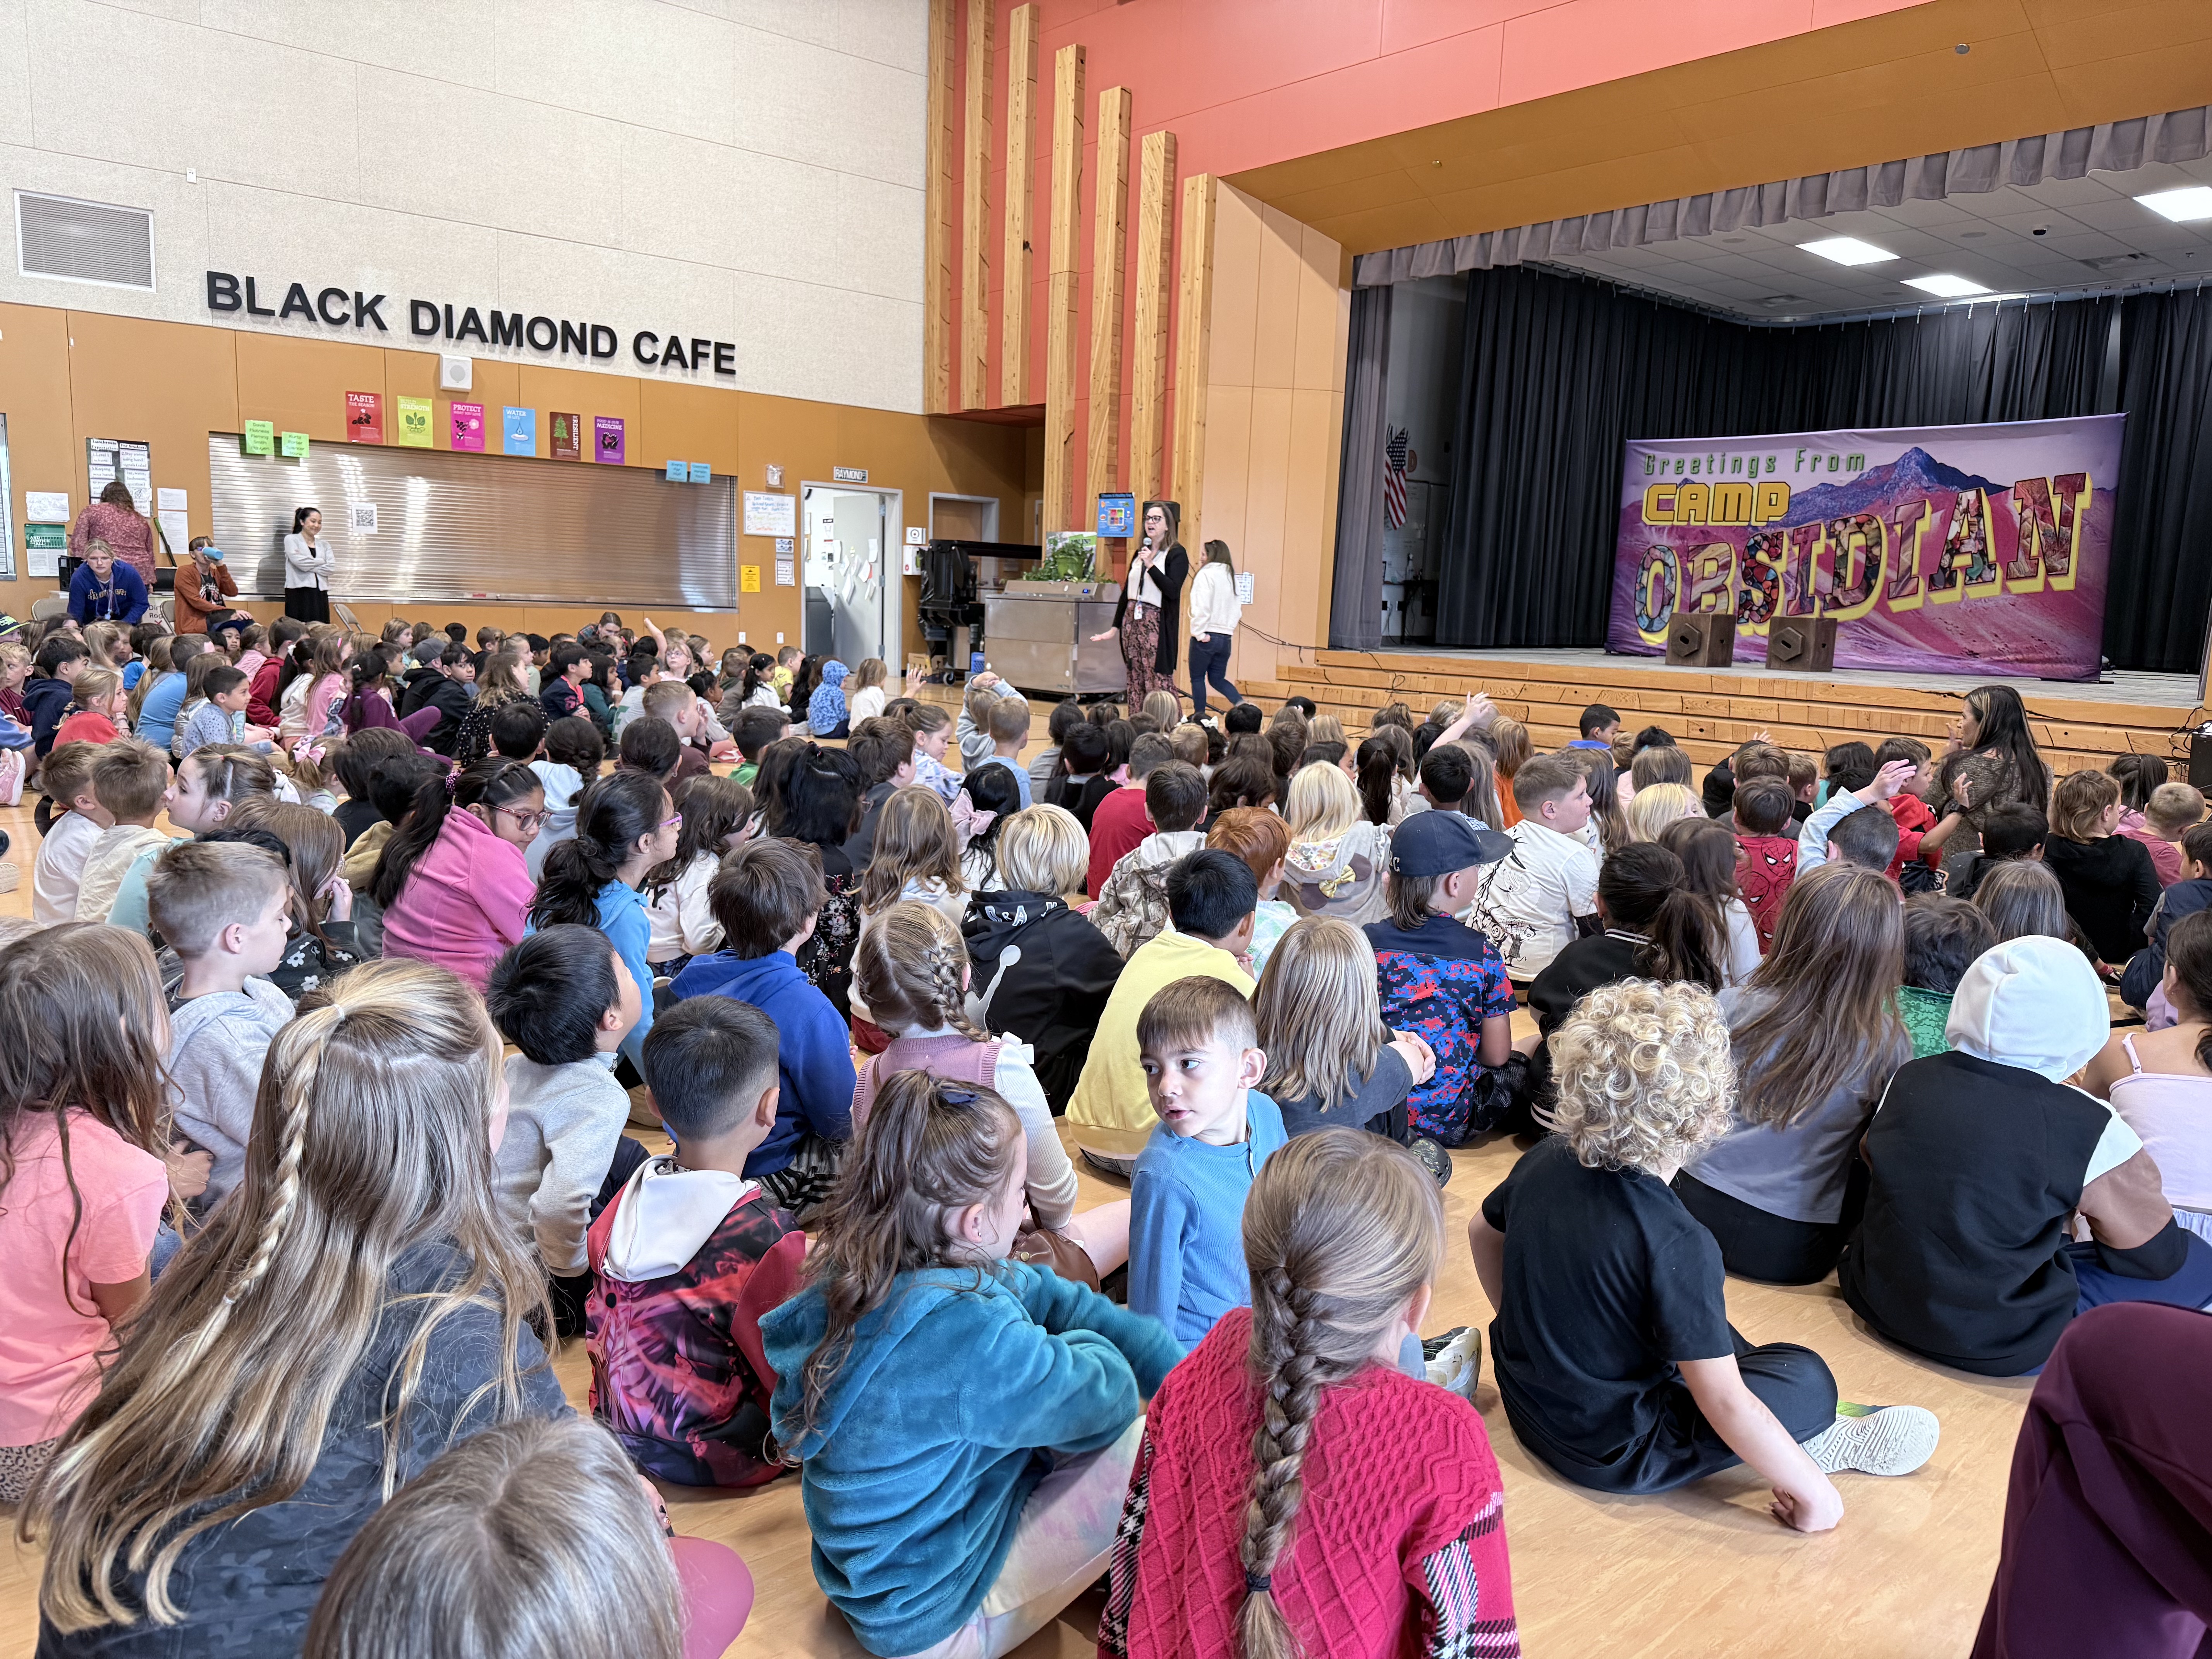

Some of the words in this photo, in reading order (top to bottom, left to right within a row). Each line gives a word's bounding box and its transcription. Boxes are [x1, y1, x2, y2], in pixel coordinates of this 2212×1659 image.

[207, 271, 388, 330] BLACK
[410, 299, 618, 358] DIAMOND
[634, 331, 736, 374] CAFE
[348, 394, 374, 403] TASTE
[453, 404, 481, 412] PROTECT
[836, 469, 862, 480] RAYMOND
[1644, 452, 1777, 478] Greetings
[1795, 448, 1865, 472] From
[1642, 482, 1790, 526] CAMP
[1634, 472, 2093, 645] OBSIDIAN
